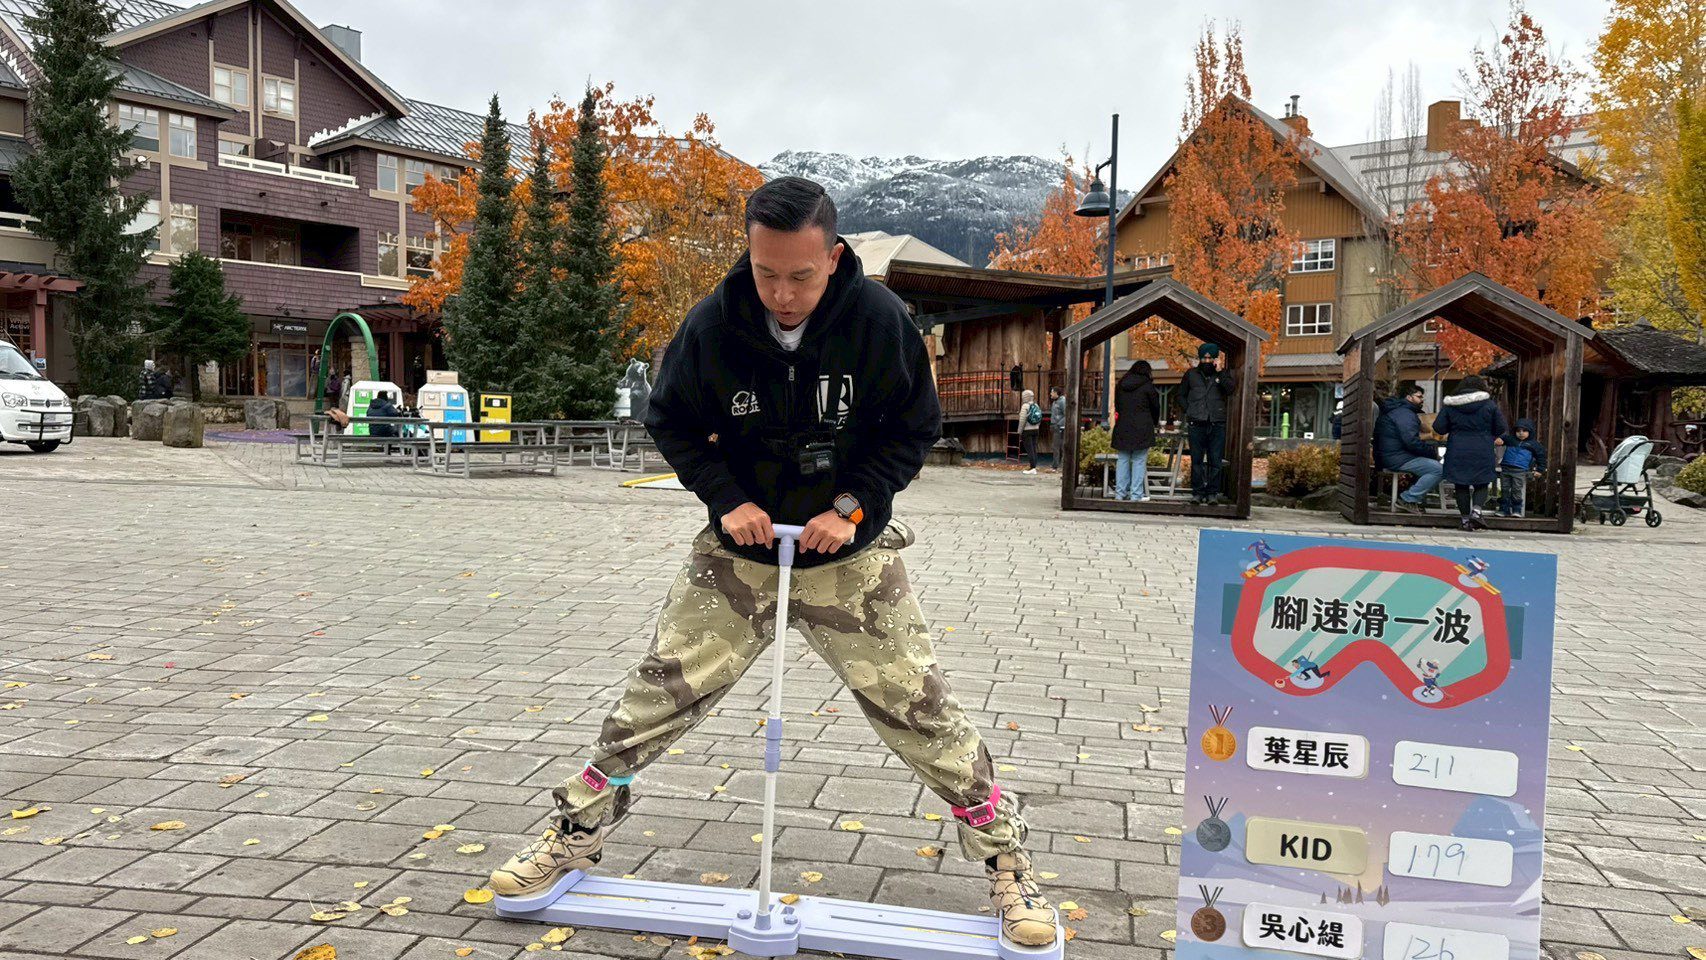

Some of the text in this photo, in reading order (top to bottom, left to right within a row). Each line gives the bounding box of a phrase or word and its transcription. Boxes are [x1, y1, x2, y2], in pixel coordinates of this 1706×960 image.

[1270, 595, 1472, 645] 腳速滑一波
[1214, 732, 1225, 755] 1
[1263, 735, 1350, 770] 葉星辰
[1408, 752, 1455, 779] 211
[1279, 833, 1333, 862] KID
[1406, 842, 1466, 878] 179
[1202, 914, 1217, 933] 3
[1258, 912, 1345, 949] 吳心緹
